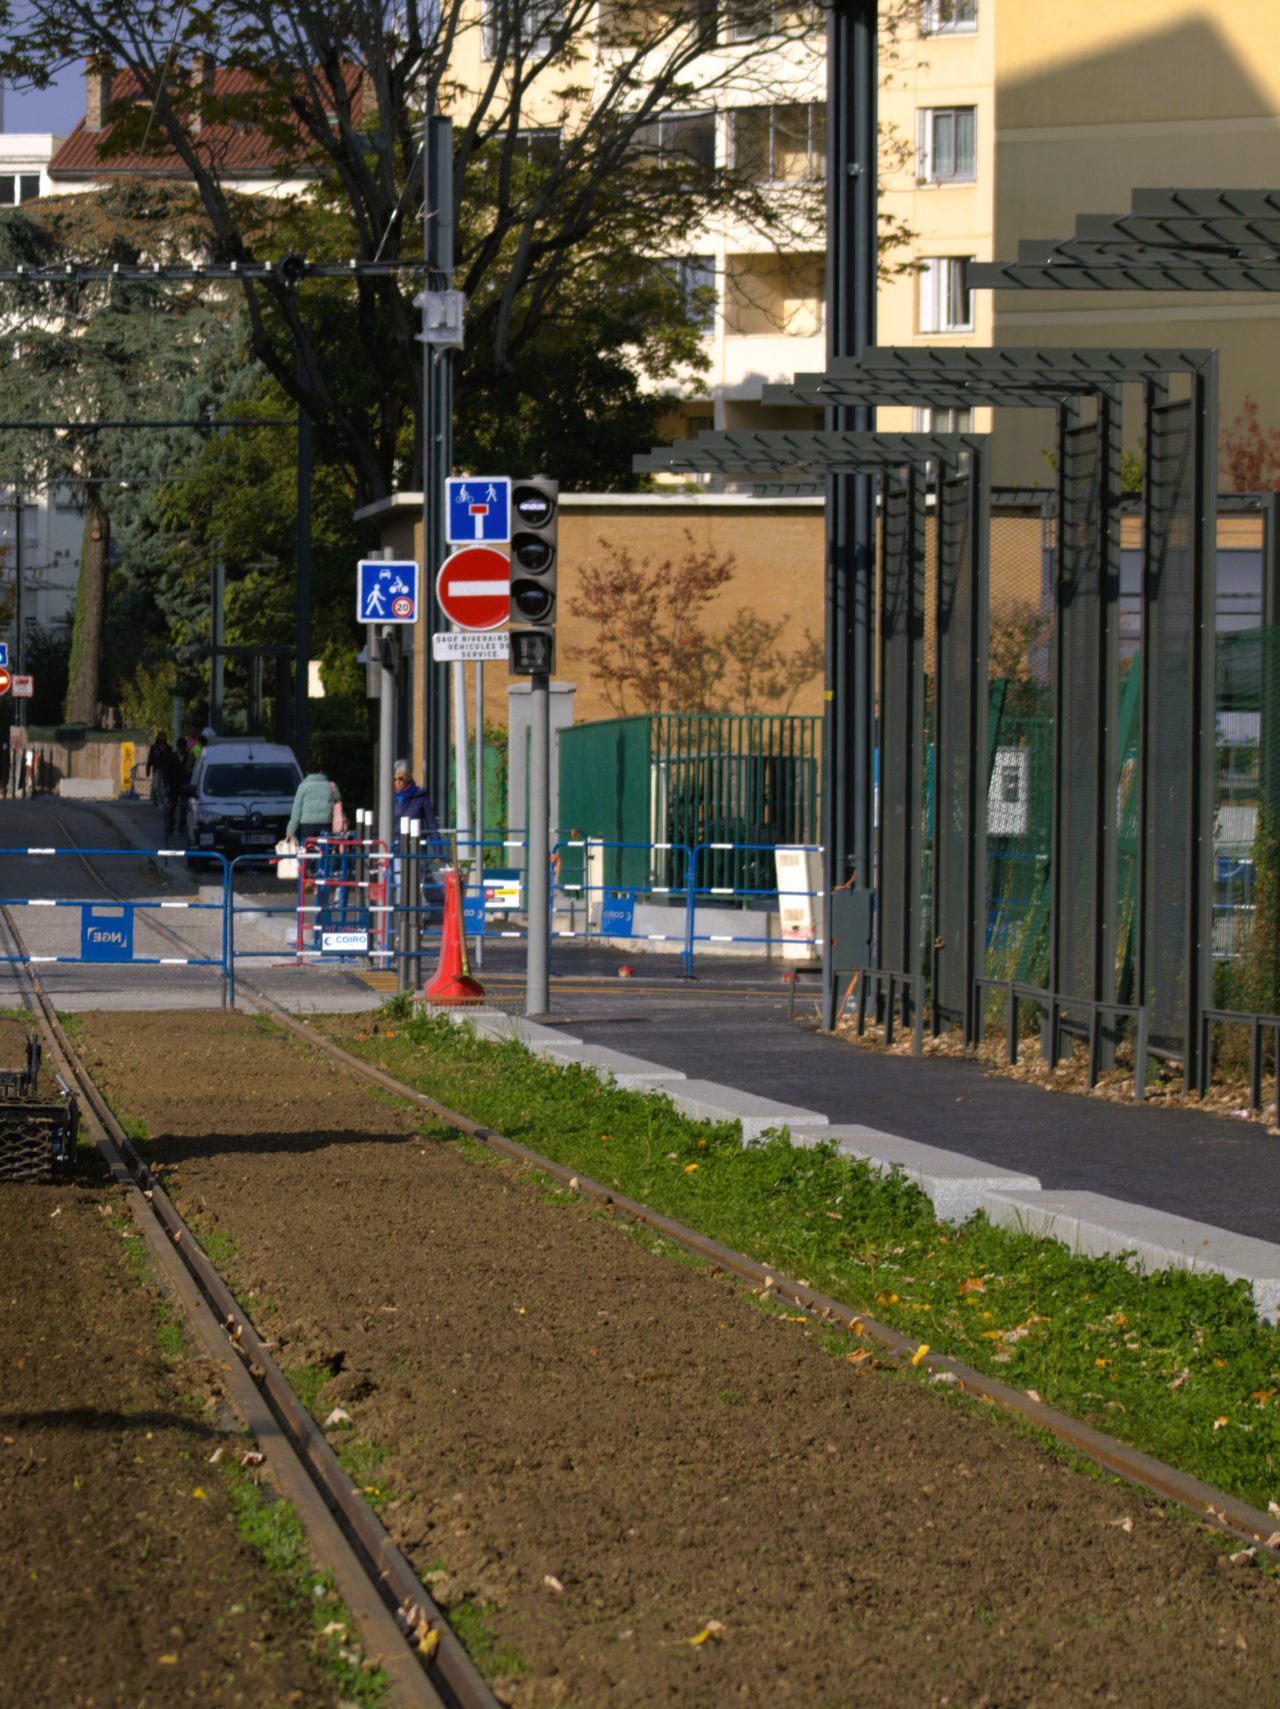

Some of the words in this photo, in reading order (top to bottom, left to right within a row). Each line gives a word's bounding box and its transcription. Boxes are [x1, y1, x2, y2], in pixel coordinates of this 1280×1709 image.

[396, 603, 409, 612] 20
[436, 635, 457, 643] SAUF
[461, 634, 508, 642] RIVERAINS
[461, 650, 497, 658] SERVICE
[335, 935, 367, 944] COIRO
